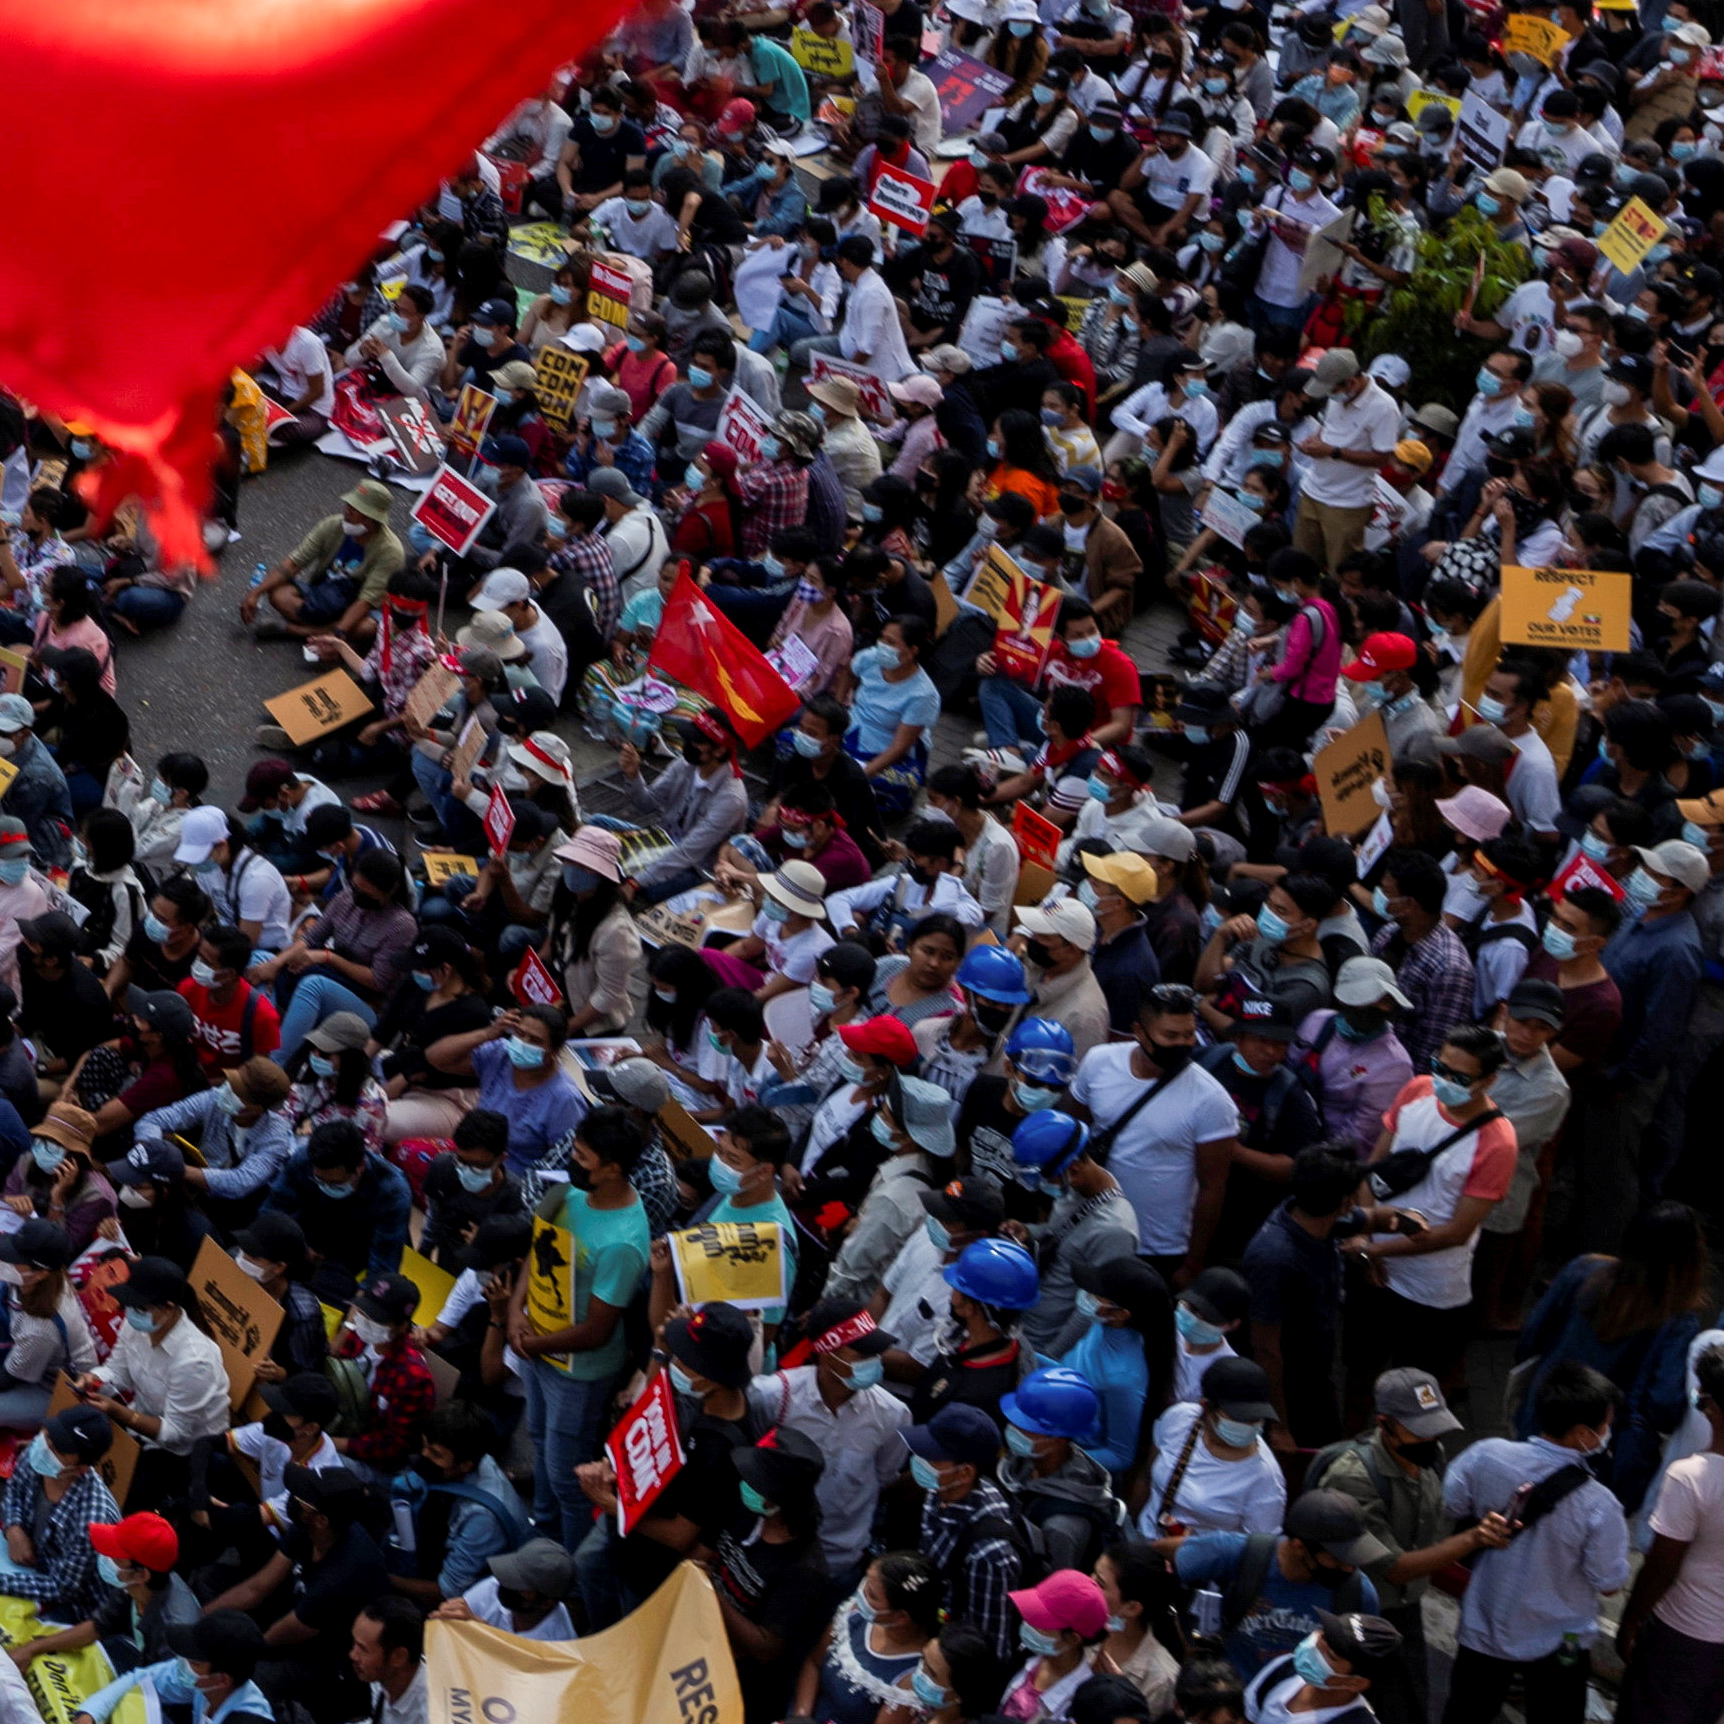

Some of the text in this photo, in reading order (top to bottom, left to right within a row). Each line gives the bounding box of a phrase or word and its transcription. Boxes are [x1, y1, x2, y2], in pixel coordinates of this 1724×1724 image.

[587, 290, 628, 328] CDM
[540, 347, 583, 377] CDM
[537, 367, 578, 398] CDM
[1534, 569, 1597, 587] RESPECT
[1528, 622, 1603, 637] OUR VOTES
[1243, 999, 1274, 1018] NIKE
